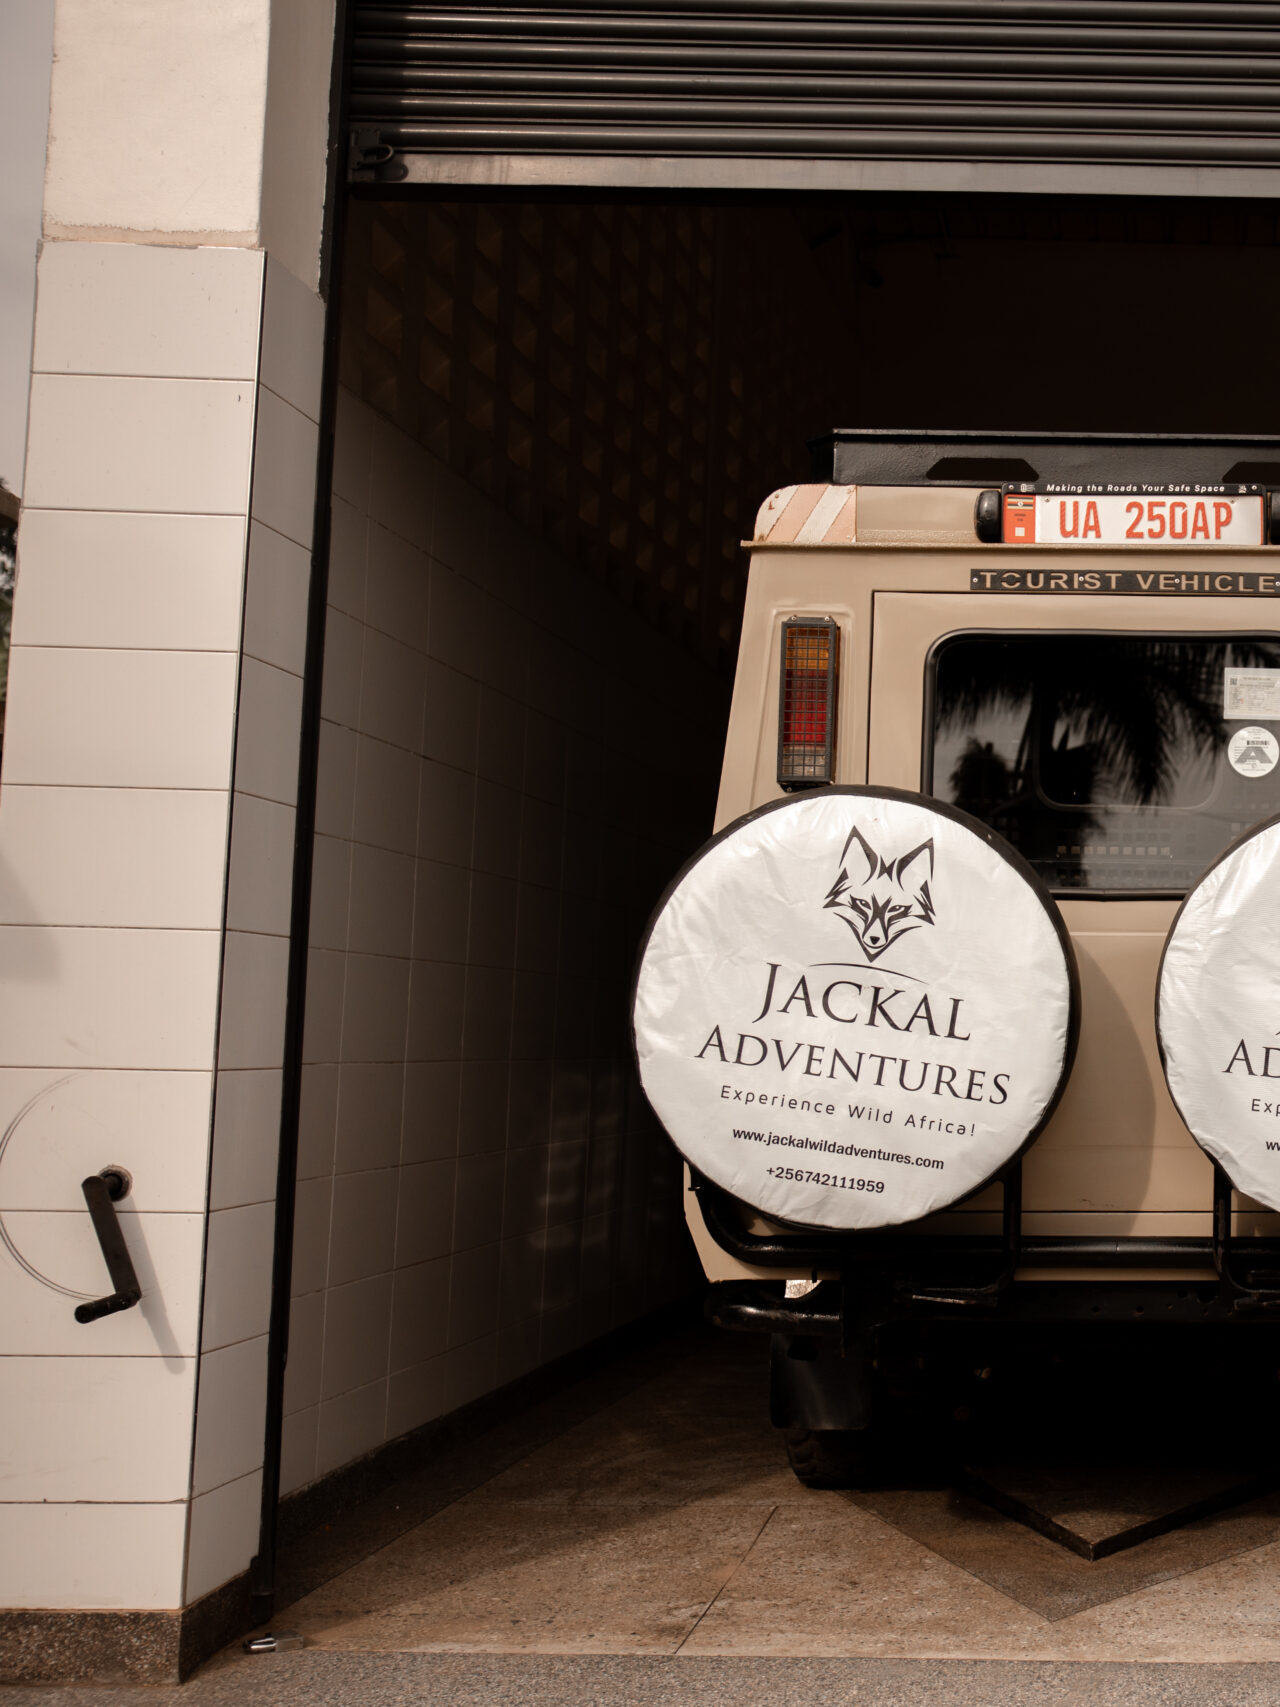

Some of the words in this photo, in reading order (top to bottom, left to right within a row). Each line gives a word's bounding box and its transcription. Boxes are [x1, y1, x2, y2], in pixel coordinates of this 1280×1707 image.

[1046, 483, 1083, 494] Making
[1086, 484, 1104, 493] the
[1106, 484, 1138, 493] Roads
[1141, 484, 1165, 493] Your
[1167, 484, 1191, 493] Safe
[1194, 484, 1225, 494] Space
[1059, 500, 1102, 539] UA
[1125, 501, 1233, 540] 250AP
[980, 571, 1123, 592] TOURIST
[1135, 573, 1276, 593] VEHICLE
[752, 962, 971, 1042] JACKAL
[694, 1024, 1011, 1105] ADVENTURES
[720, 1085, 836, 1116] Experience
[847, 1104, 893, 1124] Wild
[904, 1113, 976, 1136] Africa!
[732, 1128, 945, 1171] www.jackalwildadventures.com
[766, 1166, 885, 1194] +256742111959
